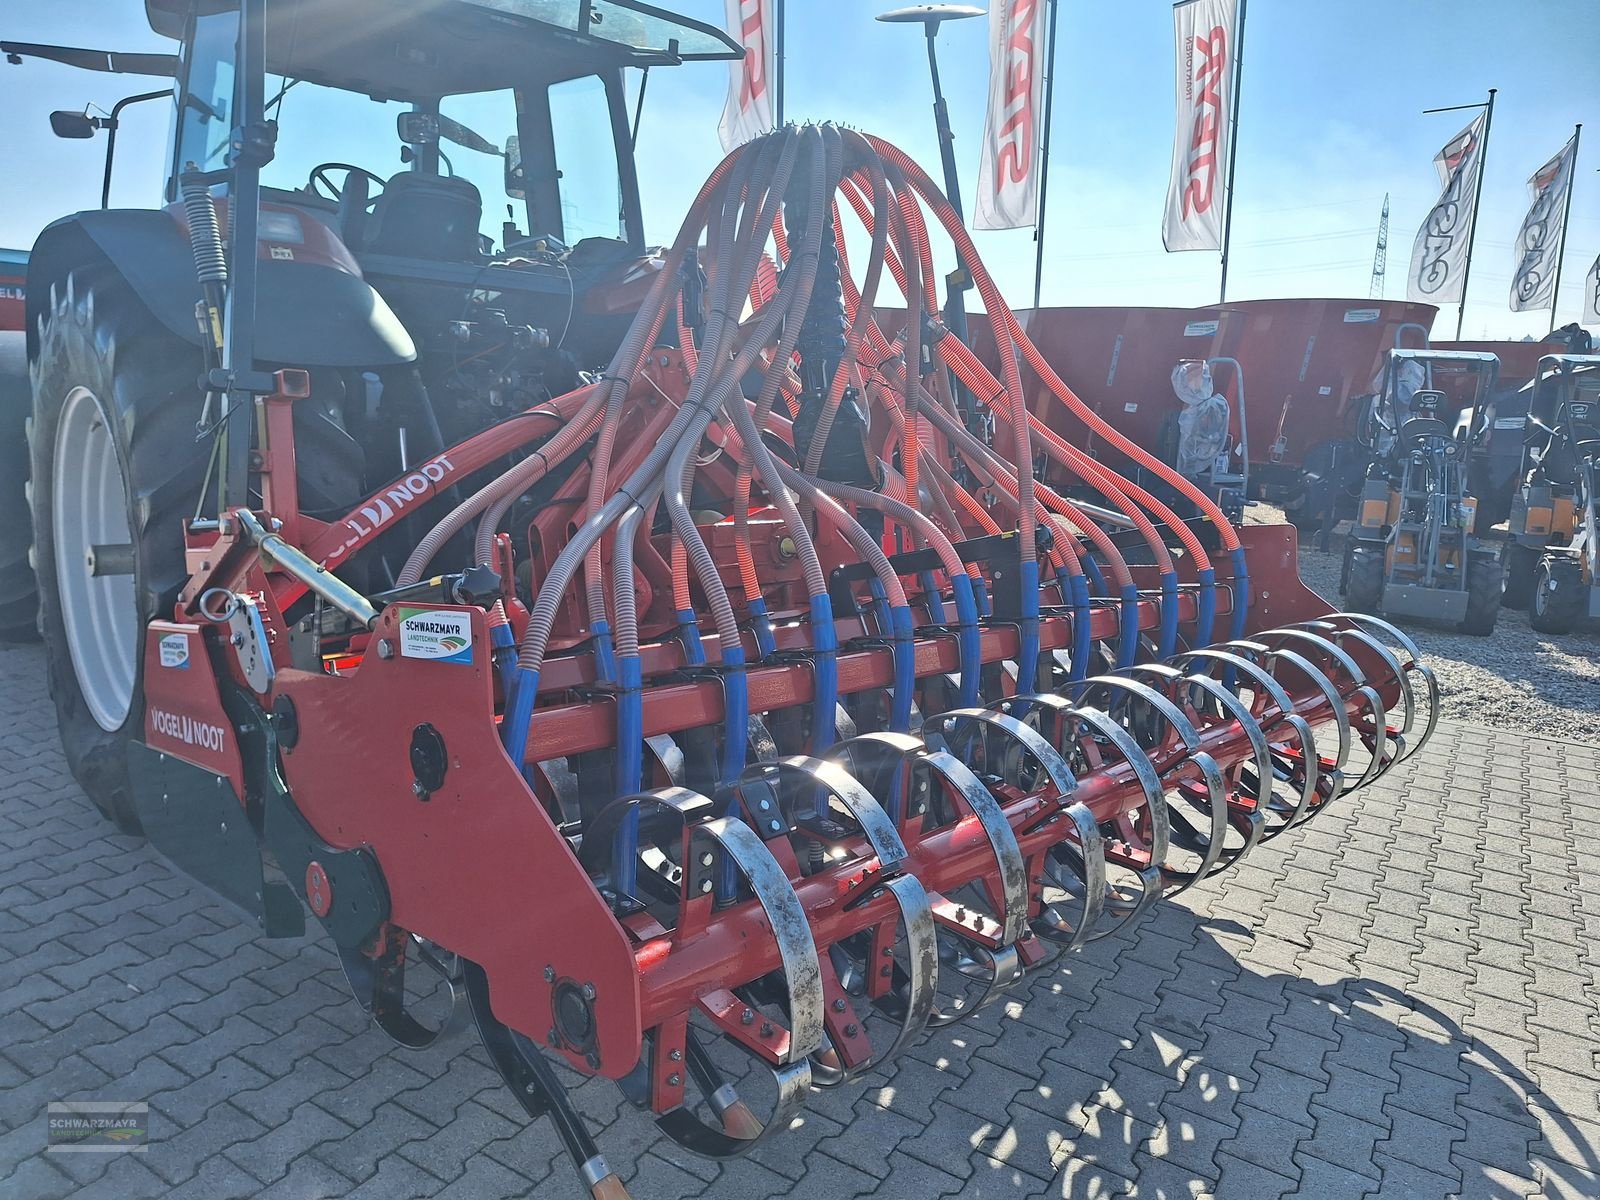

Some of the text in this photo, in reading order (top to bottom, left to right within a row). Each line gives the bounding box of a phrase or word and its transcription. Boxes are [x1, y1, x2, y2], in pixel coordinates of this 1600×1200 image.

[386, 454, 455, 509] NOOT
[405, 620, 461, 635] SCHWARZMAYR
[408, 634, 439, 643] LANDTECHNIK
[151, 708, 225, 753] VOGEL NOOT
